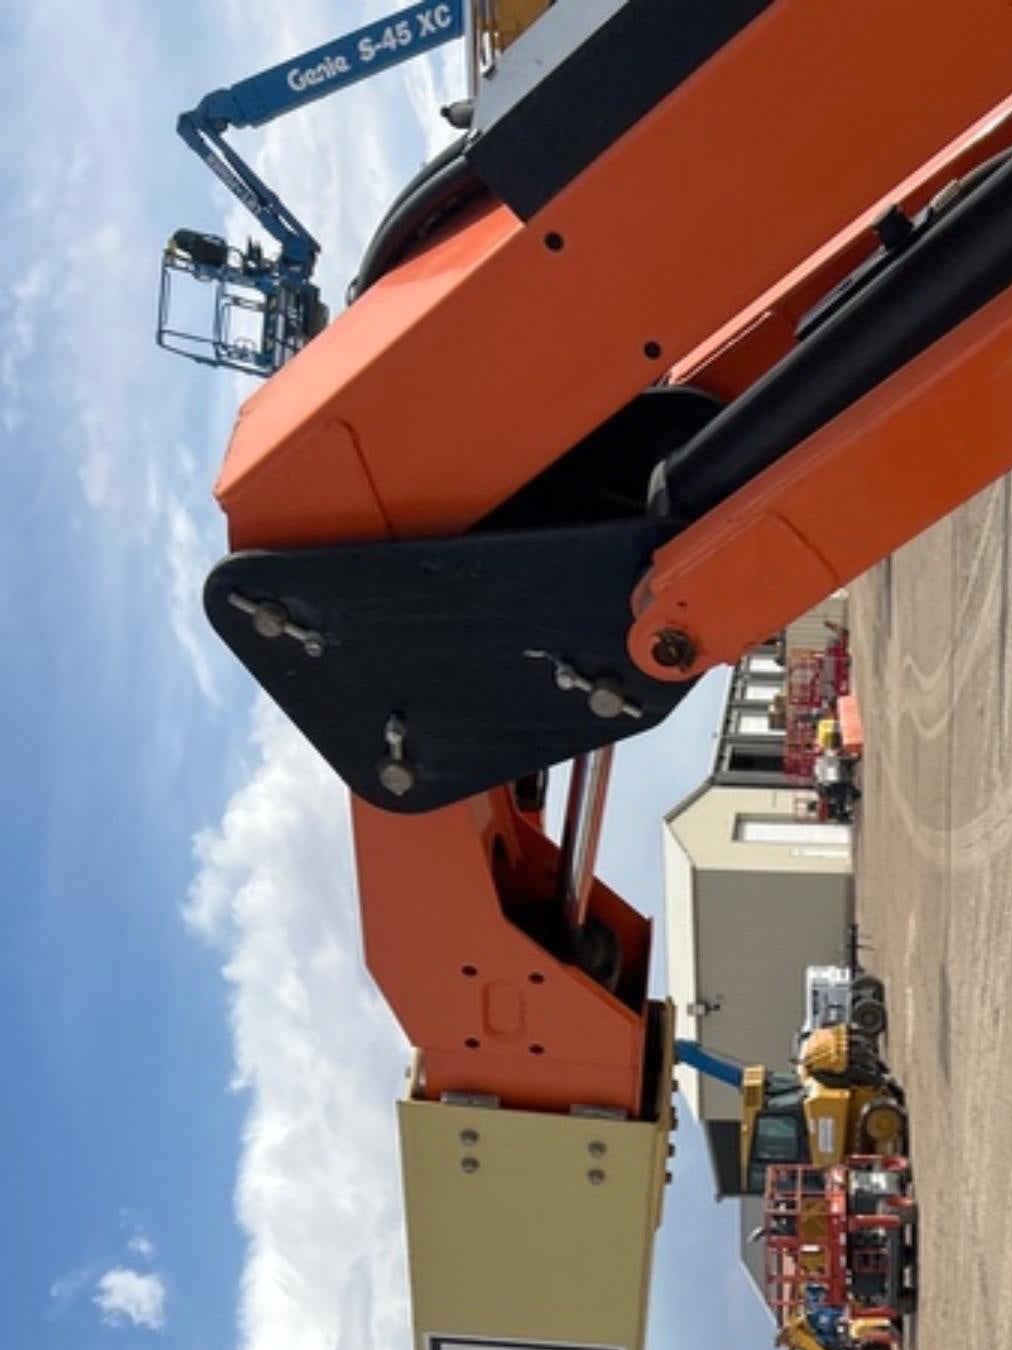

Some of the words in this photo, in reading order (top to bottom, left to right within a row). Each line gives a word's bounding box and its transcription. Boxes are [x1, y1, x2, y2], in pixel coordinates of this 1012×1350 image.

[287, 55, 350, 91] Genie
[357, 20, 413, 62] S-45
[415, 4, 452, 38] XC
